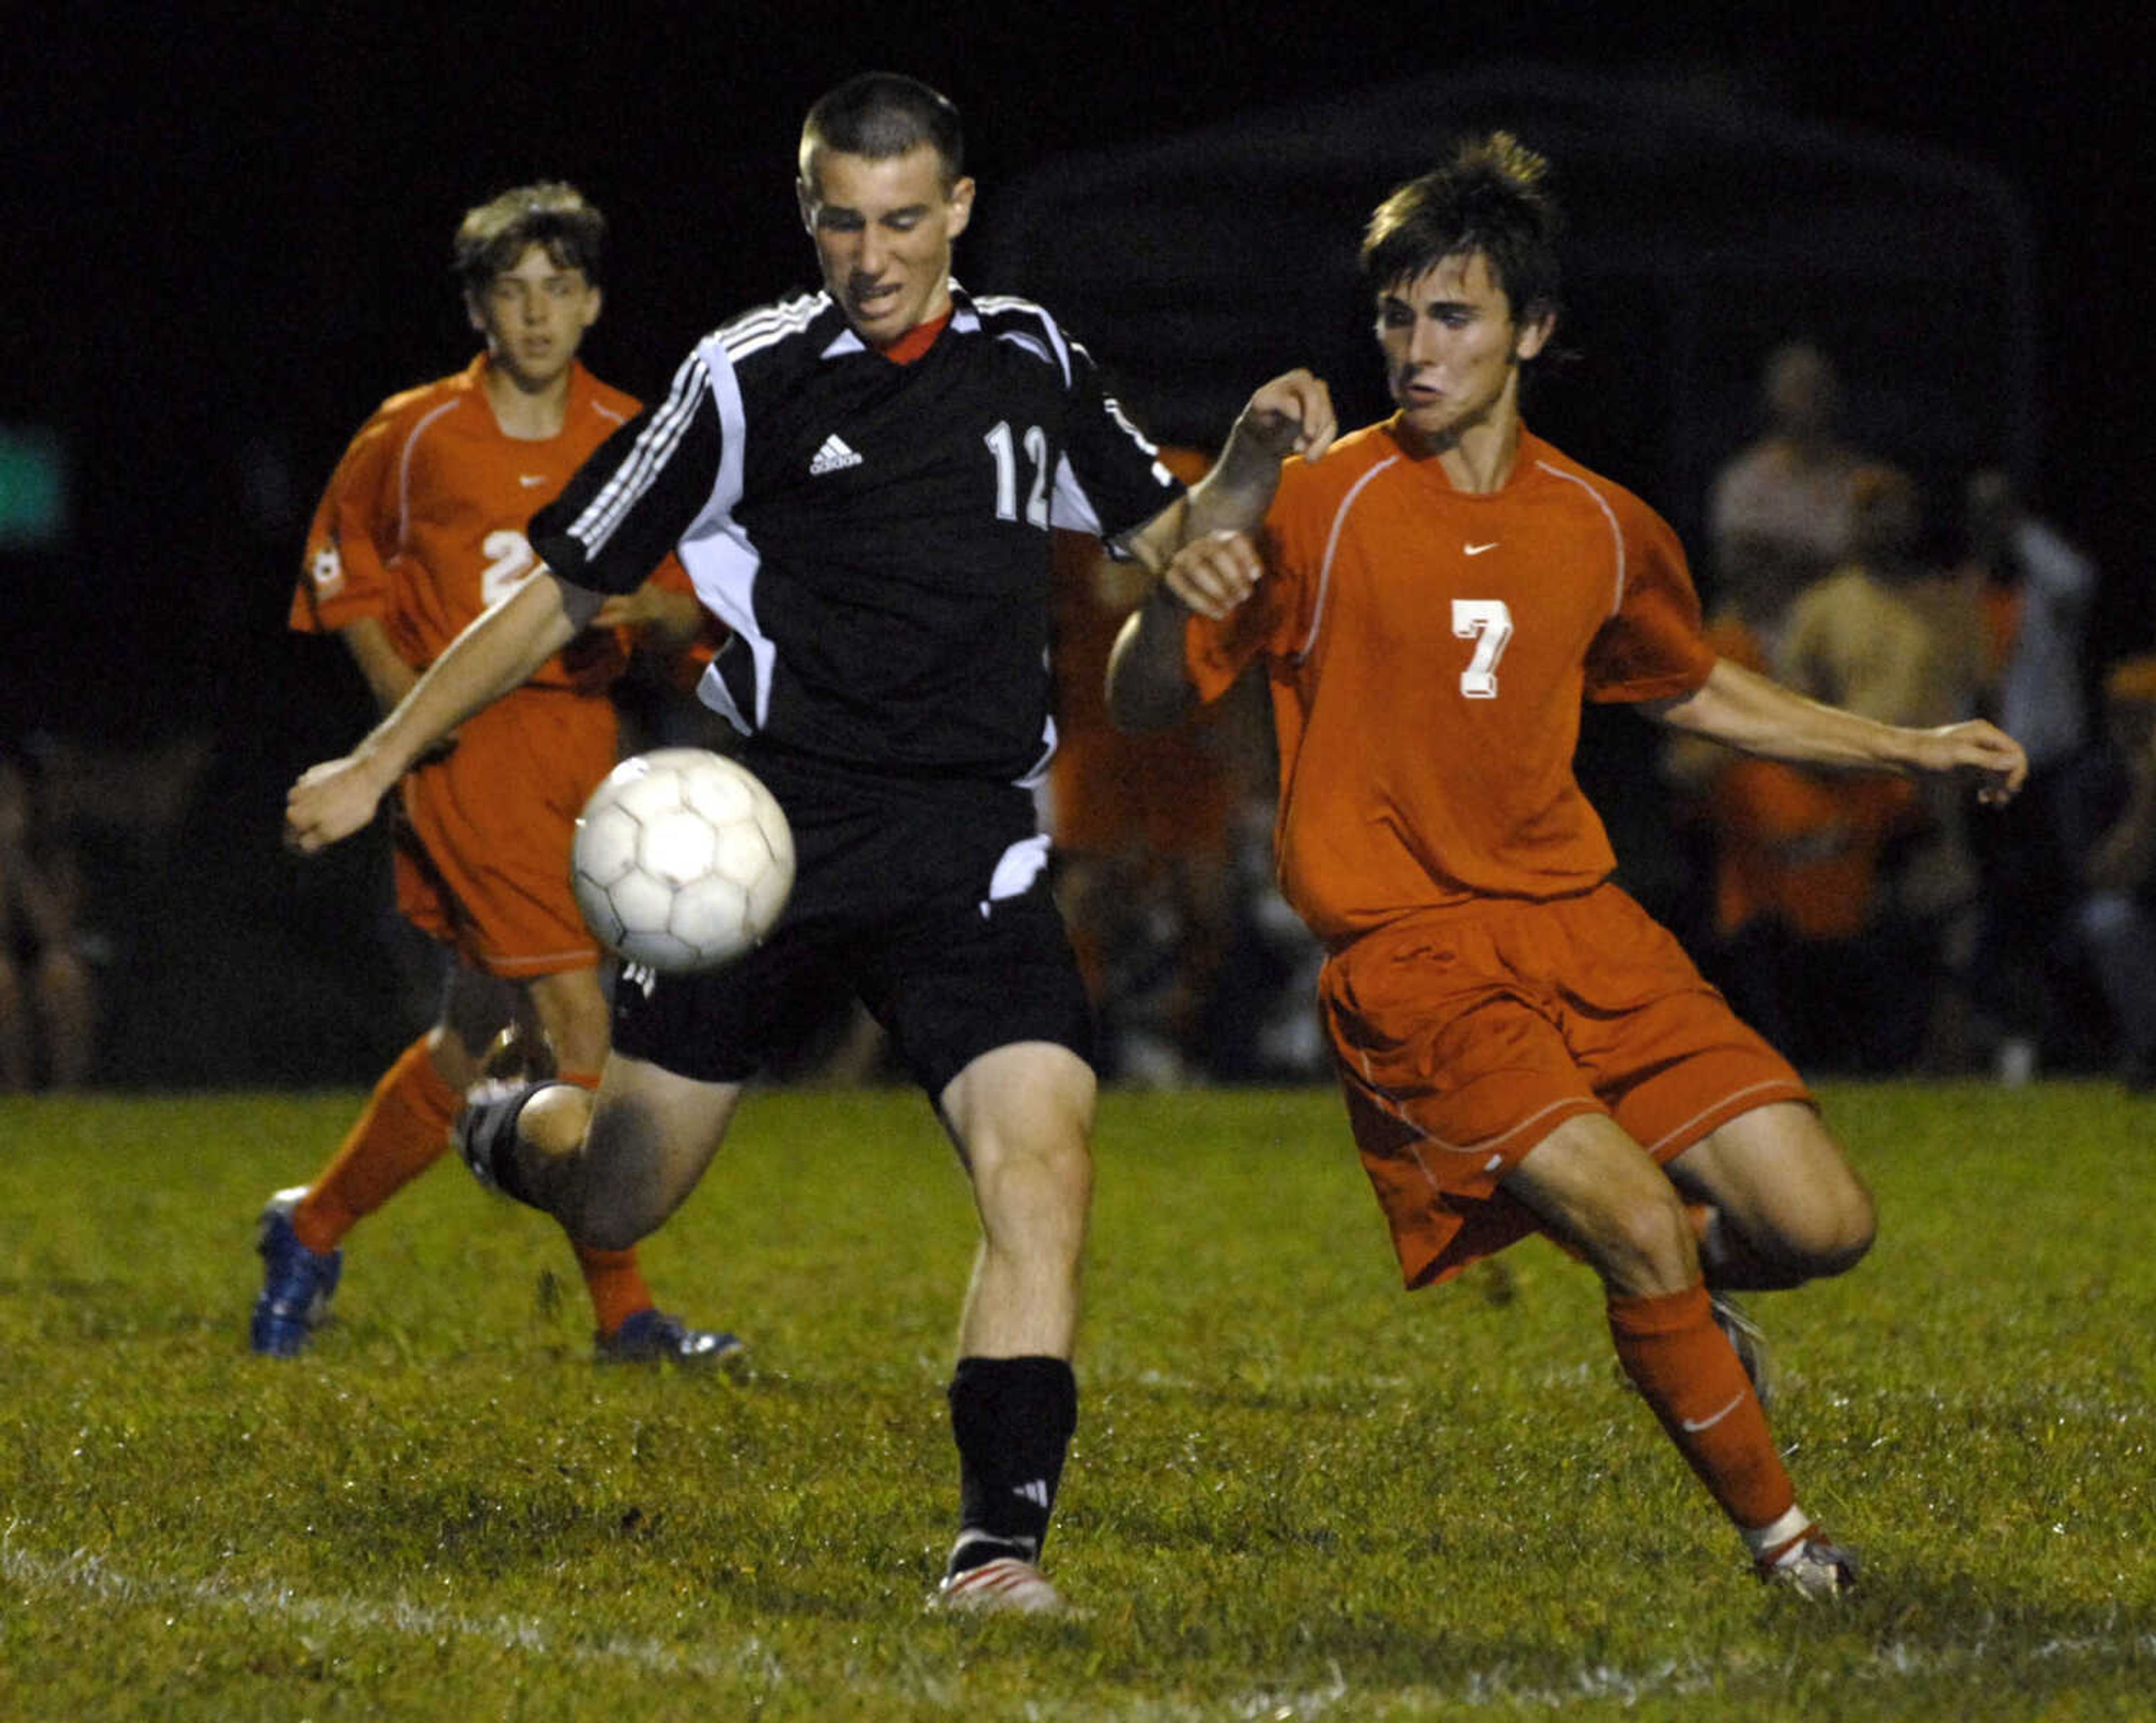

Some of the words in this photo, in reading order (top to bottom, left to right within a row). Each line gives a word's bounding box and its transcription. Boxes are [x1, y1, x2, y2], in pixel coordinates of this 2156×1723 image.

[810, 453, 862, 476] adidas
[984, 421, 1048, 531] 12
[1451, 599, 1514, 699] 7
